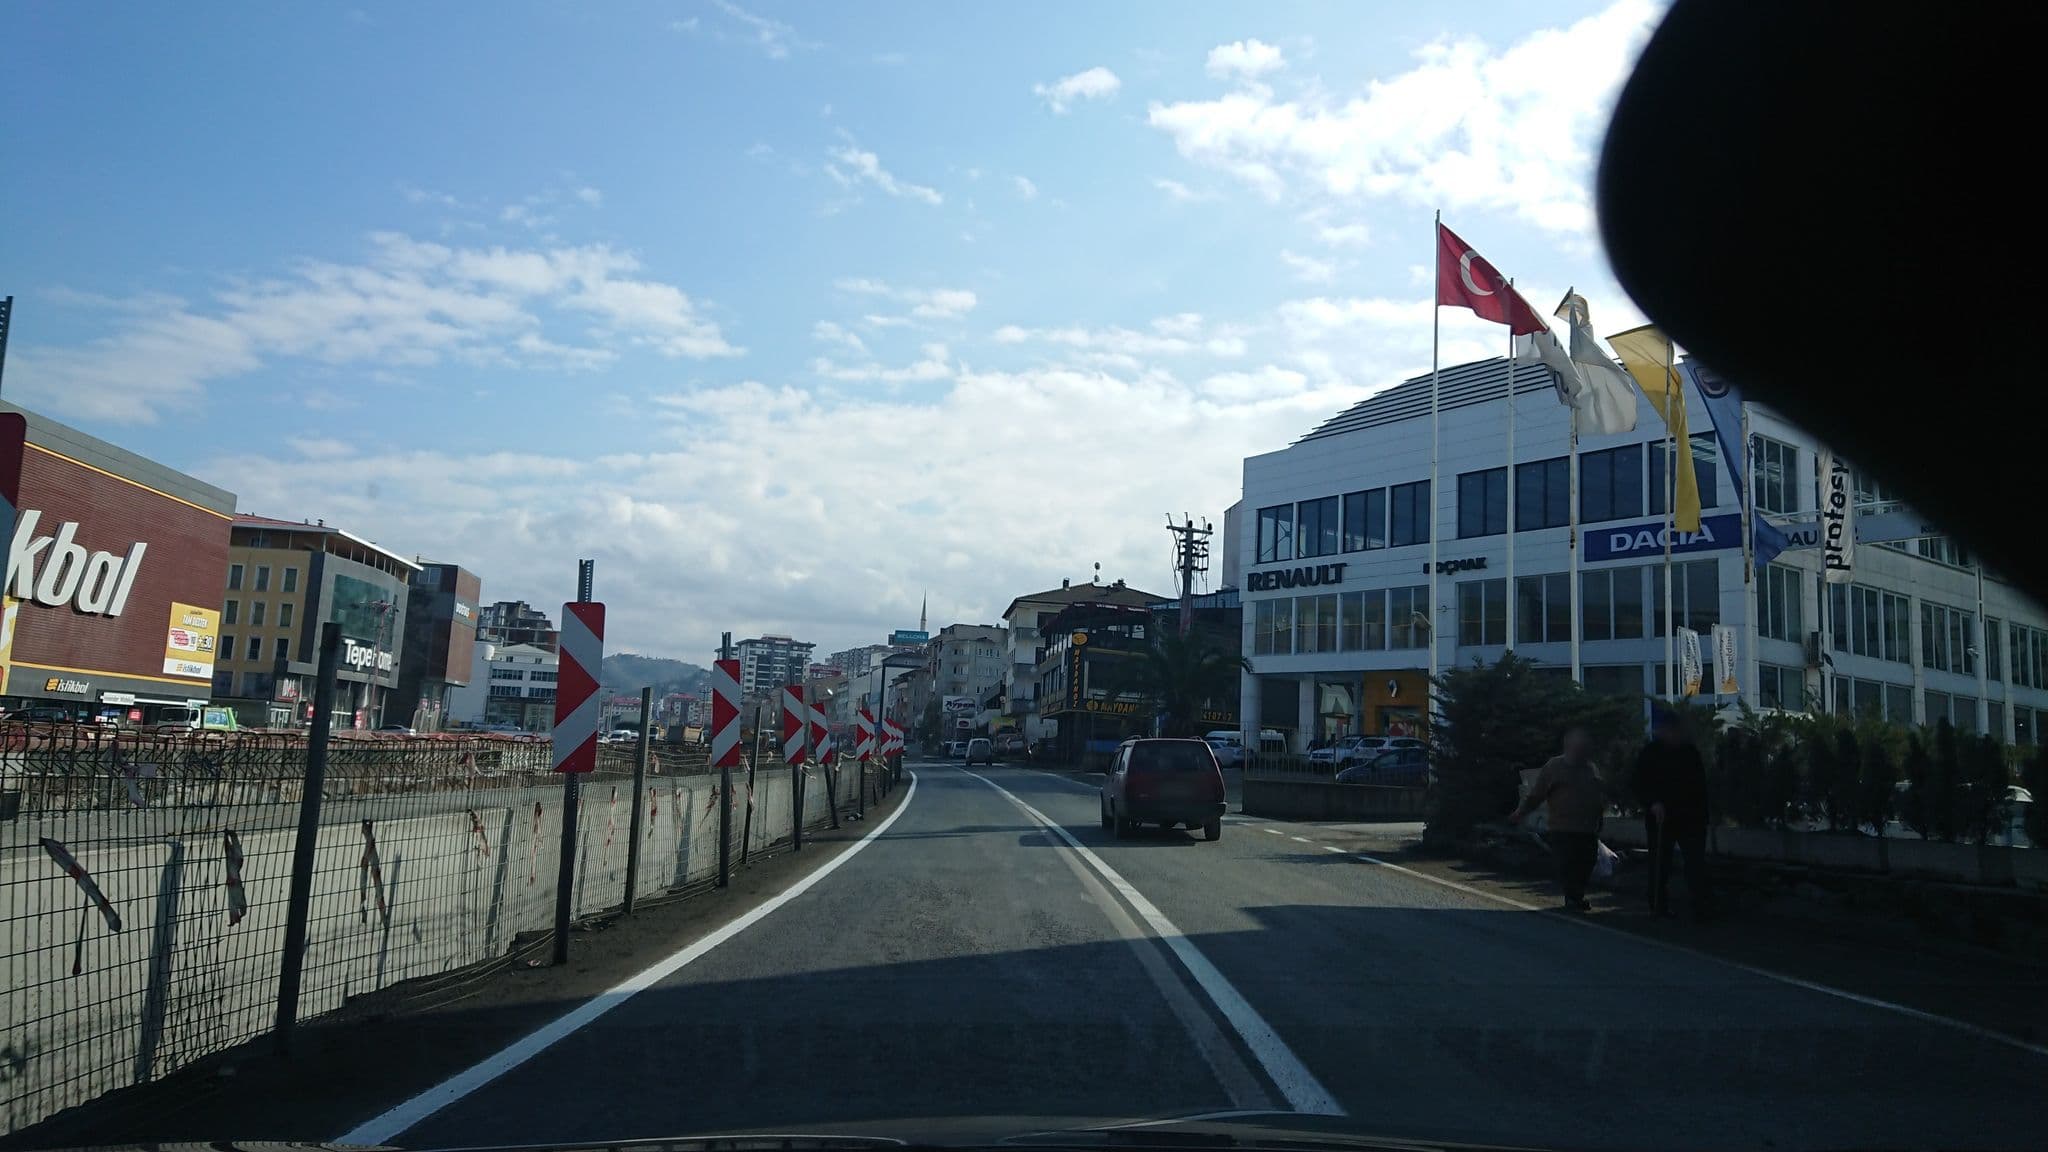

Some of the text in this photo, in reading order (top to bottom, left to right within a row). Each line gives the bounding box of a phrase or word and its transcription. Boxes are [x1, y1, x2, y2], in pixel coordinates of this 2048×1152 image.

[1610, 523, 1716, 552] DACIA
[1247, 562, 1347, 592] RENAULT
[56, 679, 90, 694] istikbal
